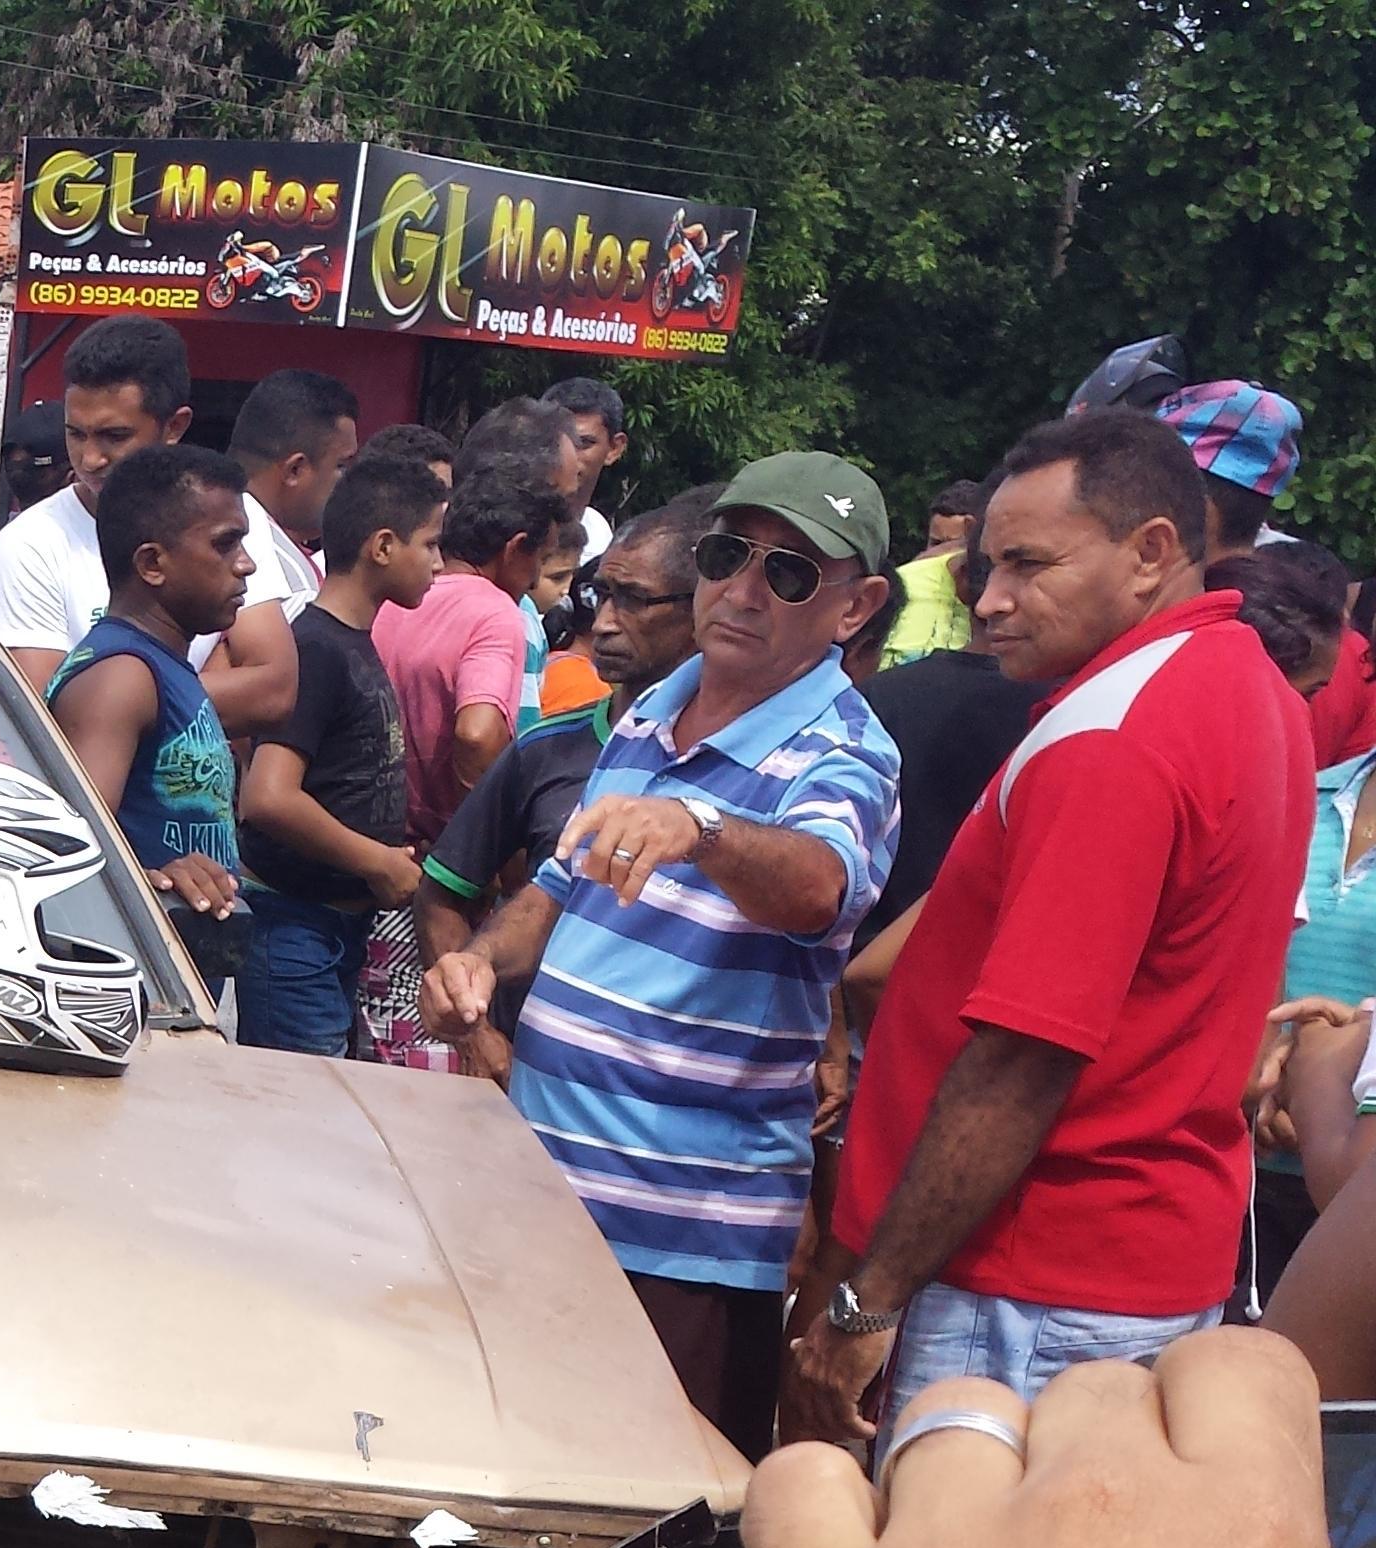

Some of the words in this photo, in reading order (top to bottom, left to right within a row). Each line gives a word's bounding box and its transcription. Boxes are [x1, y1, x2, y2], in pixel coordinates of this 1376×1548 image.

[33, 150, 149, 237] GL
[159, 163, 340, 225] Motos
[28, 252, 81, 276] Peças
[86, 254, 102, 273] &
[105, 252, 207, 276] Acessórios
[371, 173, 474, 322] GL
[486, 194, 650, 300] Motos
[29, 281, 76, 305] (86)
[79, 285, 199, 310] 9934-0822
[475, 300, 529, 341] Peças
[531, 310, 547, 337] &
[549, 309, 637, 345] Acessórios
[642, 325, 668, 351] (86)
[668, 328, 729, 355] 9934-0822
